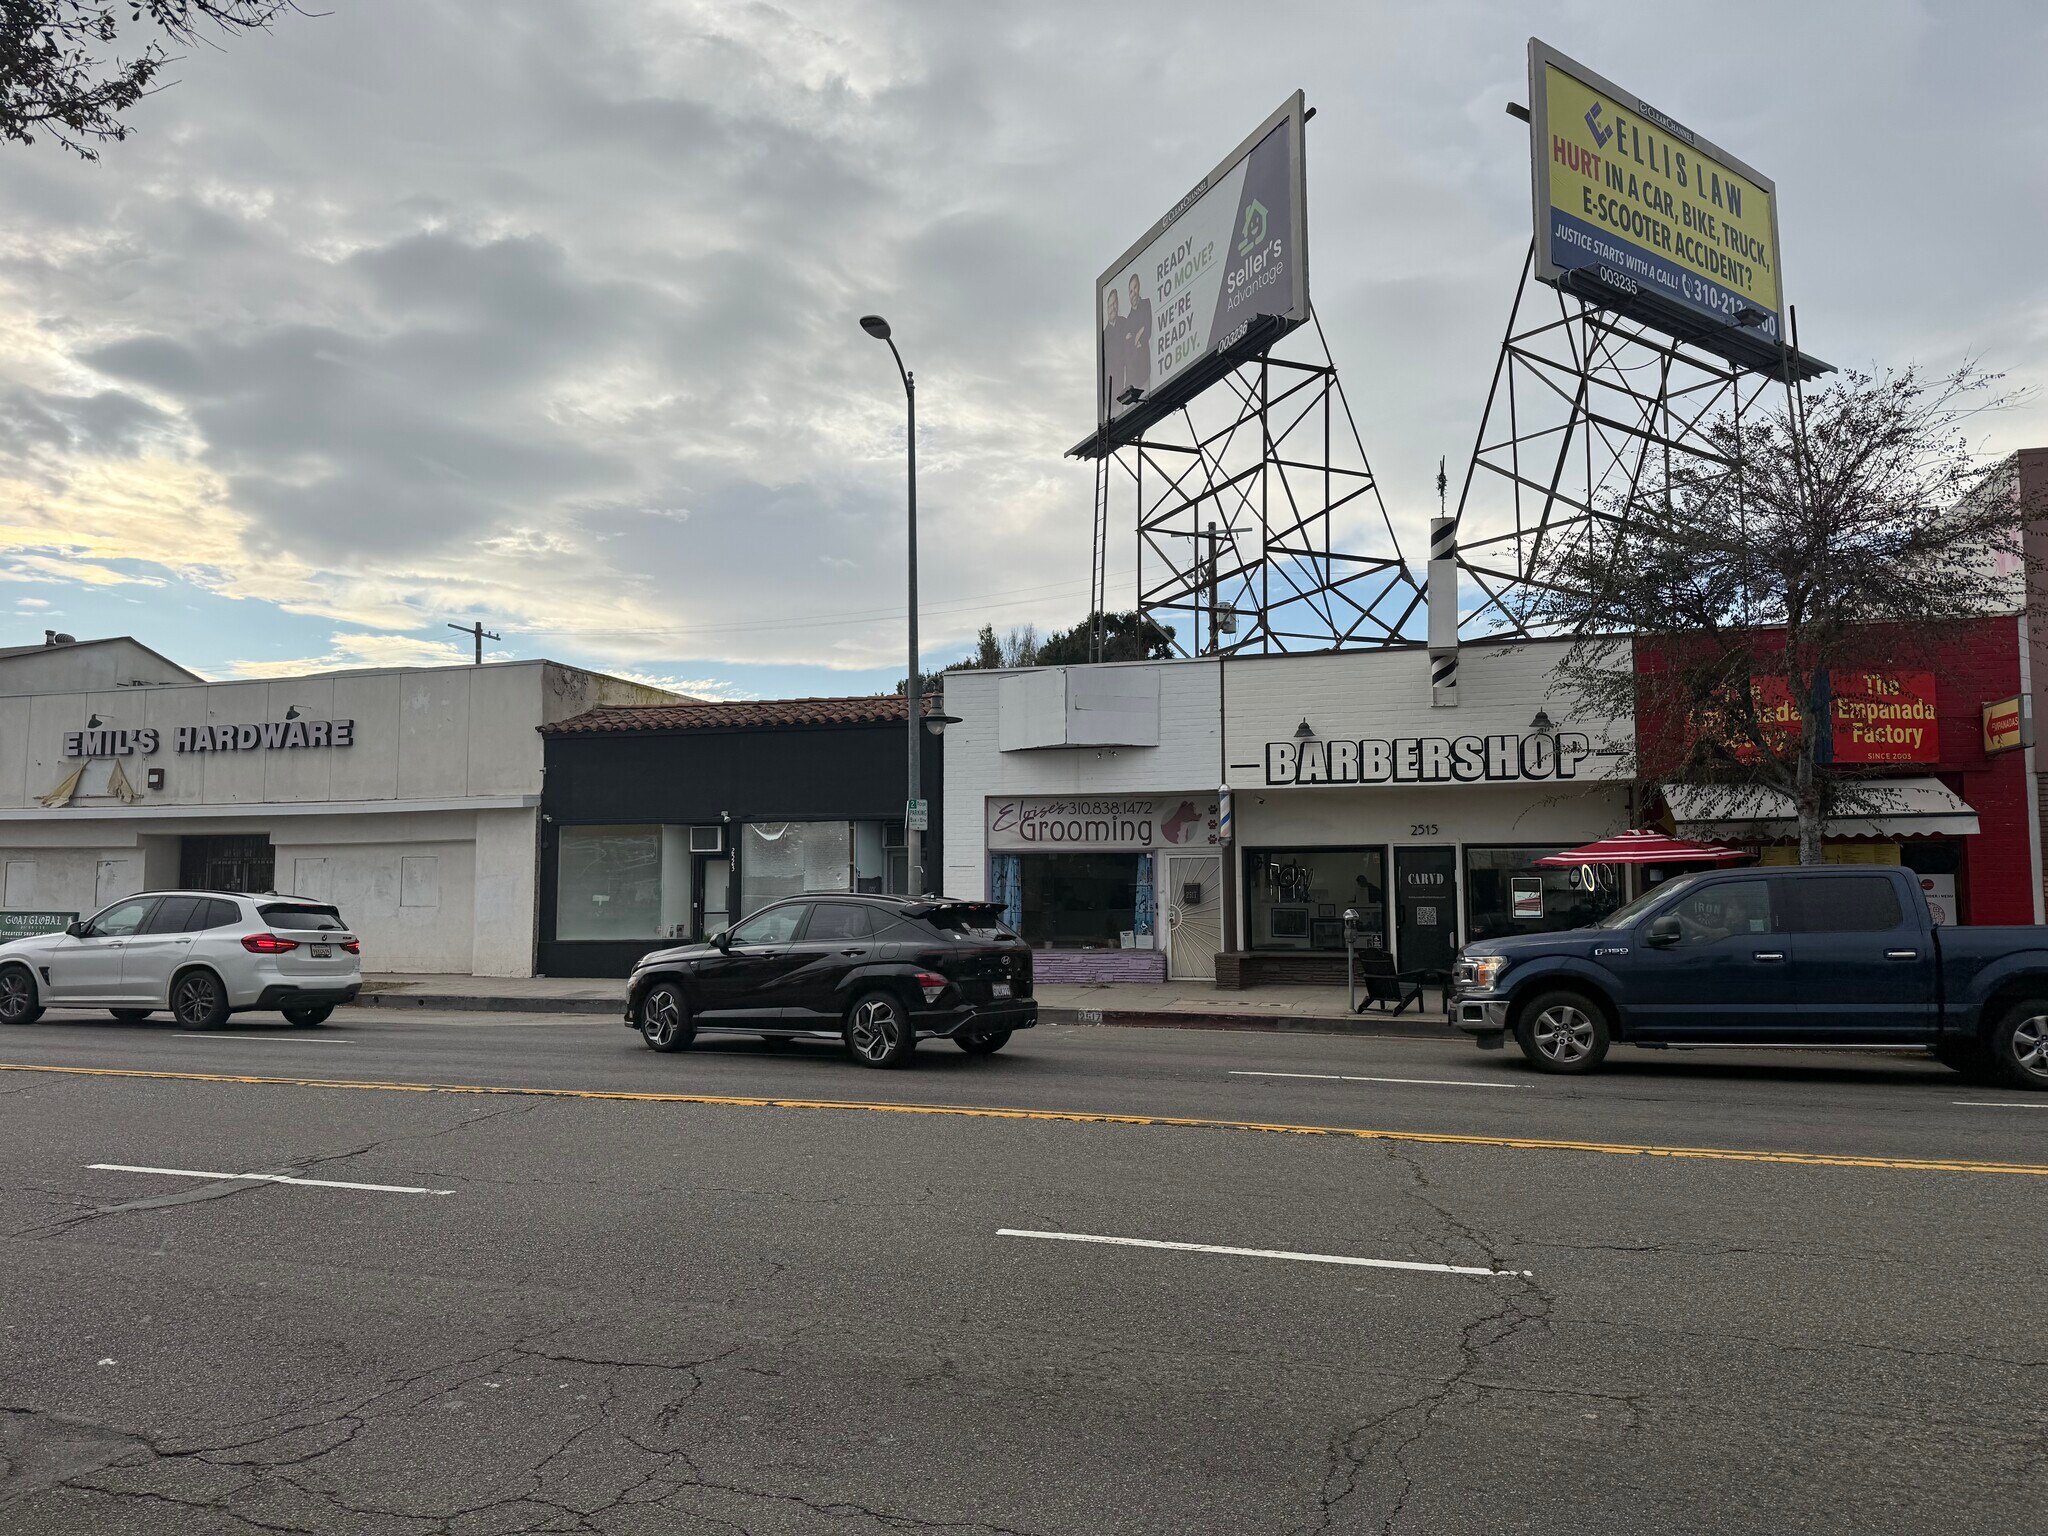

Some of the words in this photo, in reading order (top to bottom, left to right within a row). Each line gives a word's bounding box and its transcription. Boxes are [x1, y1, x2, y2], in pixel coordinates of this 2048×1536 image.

[1616, 116, 1688, 188] ELLIS
[1696, 163, 1742, 219] LAW
[1553, 134, 1601, 182] HURT
[1605, 160, 1624, 194] IN
[1628, 173, 1639, 202] A
[1643, 181, 1679, 225] CAR,
[1682, 200, 1721, 247] BIKE,
[1722, 222, 1770, 273] TRUCK,
[1555, 223, 1592, 252] JUSTICE
[1593, 240, 1625, 266] STARTS
[1626, 254, 1648, 276] WITH
[1648, 265, 1655, 280] A
[1656, 268, 1679, 290] CALL!
[1583, 185, 1672, 252] E-SCOOTER
[1675, 232, 1752, 292] ACCIDENT?
[1157, 236, 1193, 282] READY
[1158, 279, 1172, 302] TO
[1174, 241, 1214, 289] MOVE?
[1227, 239, 1282, 294] Seller's
[1227, 261, 1284, 312] Advantage
[1600, 266, 1638, 295] 003235
[1158, 291, 1191, 331] WE'RE
[1158, 312, 1194, 355] READY
[1218, 320, 1248, 353] 003236
[1158, 352, 1173, 375] TO
[1175, 332, 1200, 364] BUY.
[1838, 698, 1936, 724] Empanada
[1992, 717, 2019, 732] EMPANADAS
[63, 728, 159, 756] EMIL'S
[173, 719, 354, 752] HARDWARE
[1853, 722, 1924, 749] Factory
[1265, 732, 1589, 786] BARBERSHOP
[910, 800, 915, 808] 2
[992, 800, 1068, 832] Eloise's
[1068, 801, 1153, 815] 310.838.1472
[1019, 815, 1153, 846] Grooming
[1410, 824, 1439, 836] 2515
[1407, 873, 1444, 885] CARVD
[29, 915, 62, 926] GLOBAL
